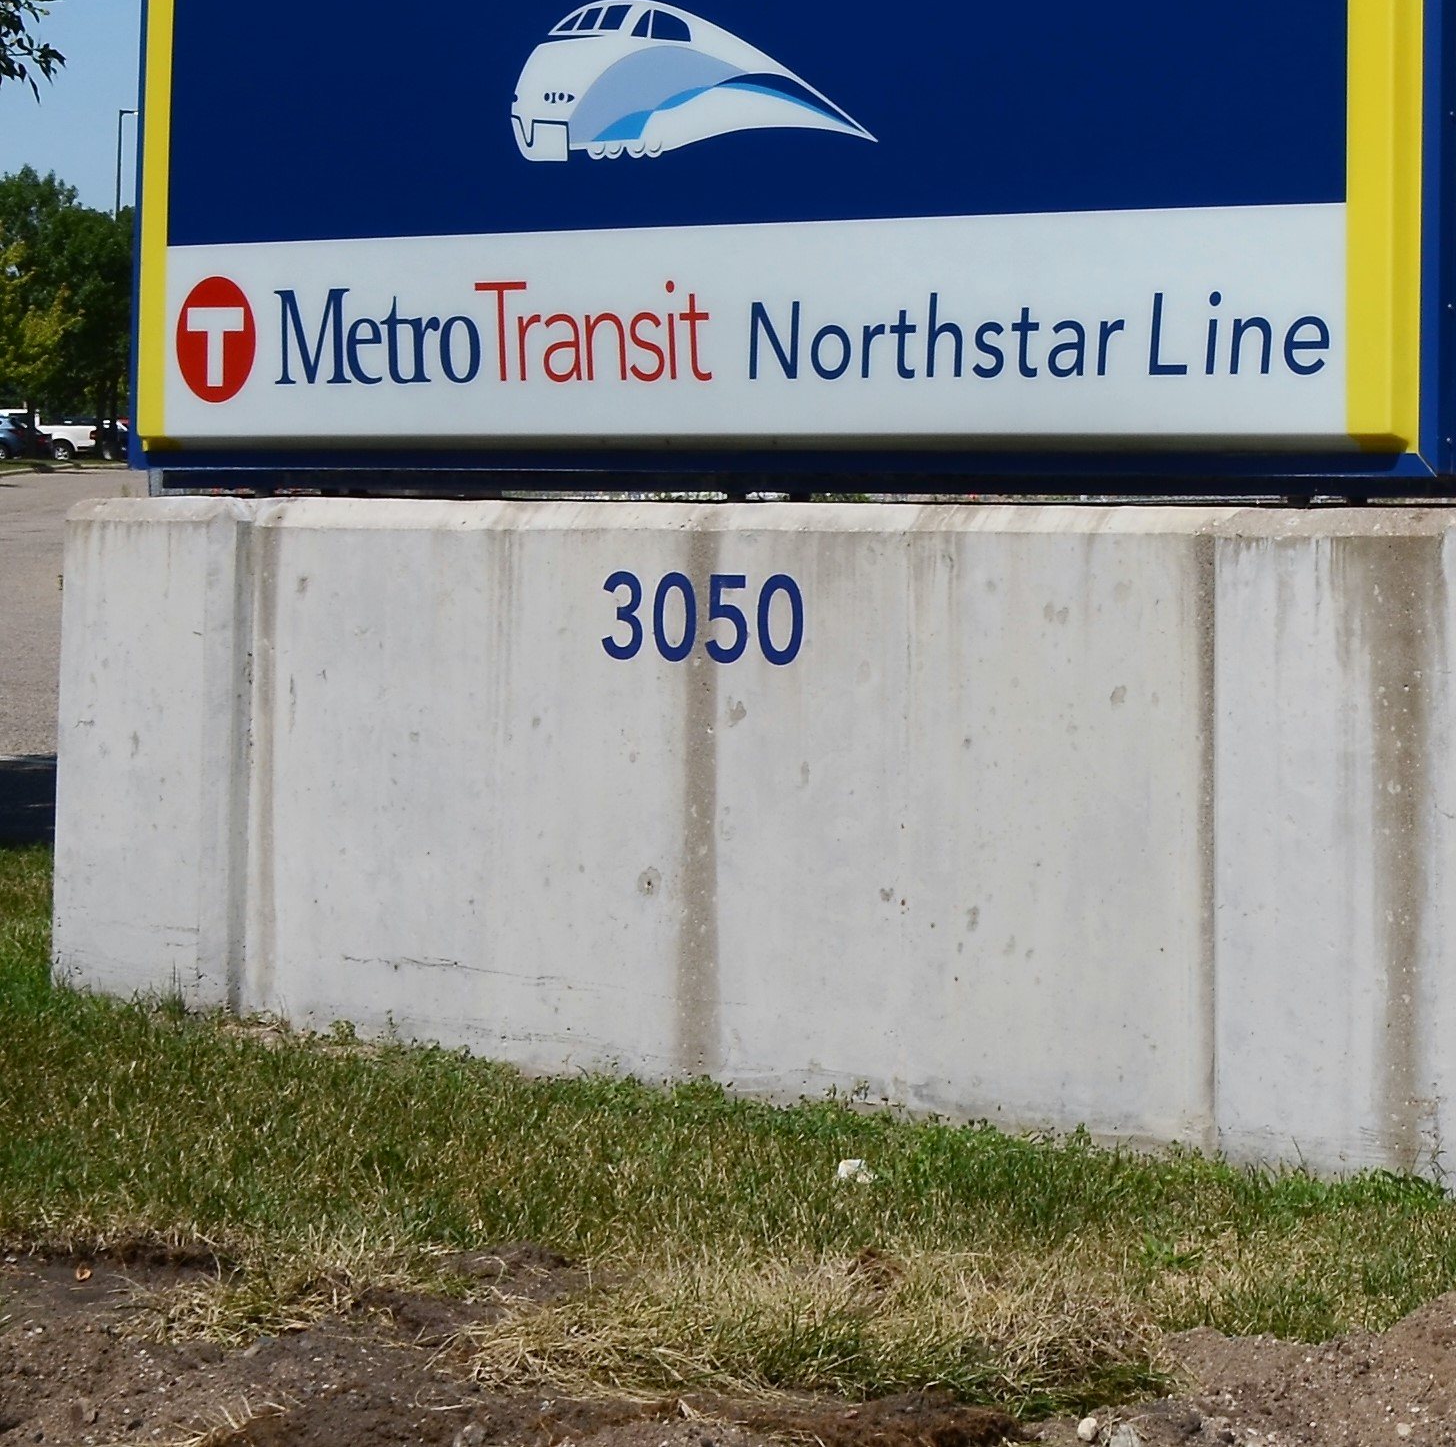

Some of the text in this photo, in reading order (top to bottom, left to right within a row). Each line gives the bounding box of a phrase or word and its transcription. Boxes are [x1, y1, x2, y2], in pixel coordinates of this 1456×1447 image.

[749, 292, 1124, 380] Northstar
[1149, 292, 1330, 376] Line
[601, 570, 804, 665] 3050
